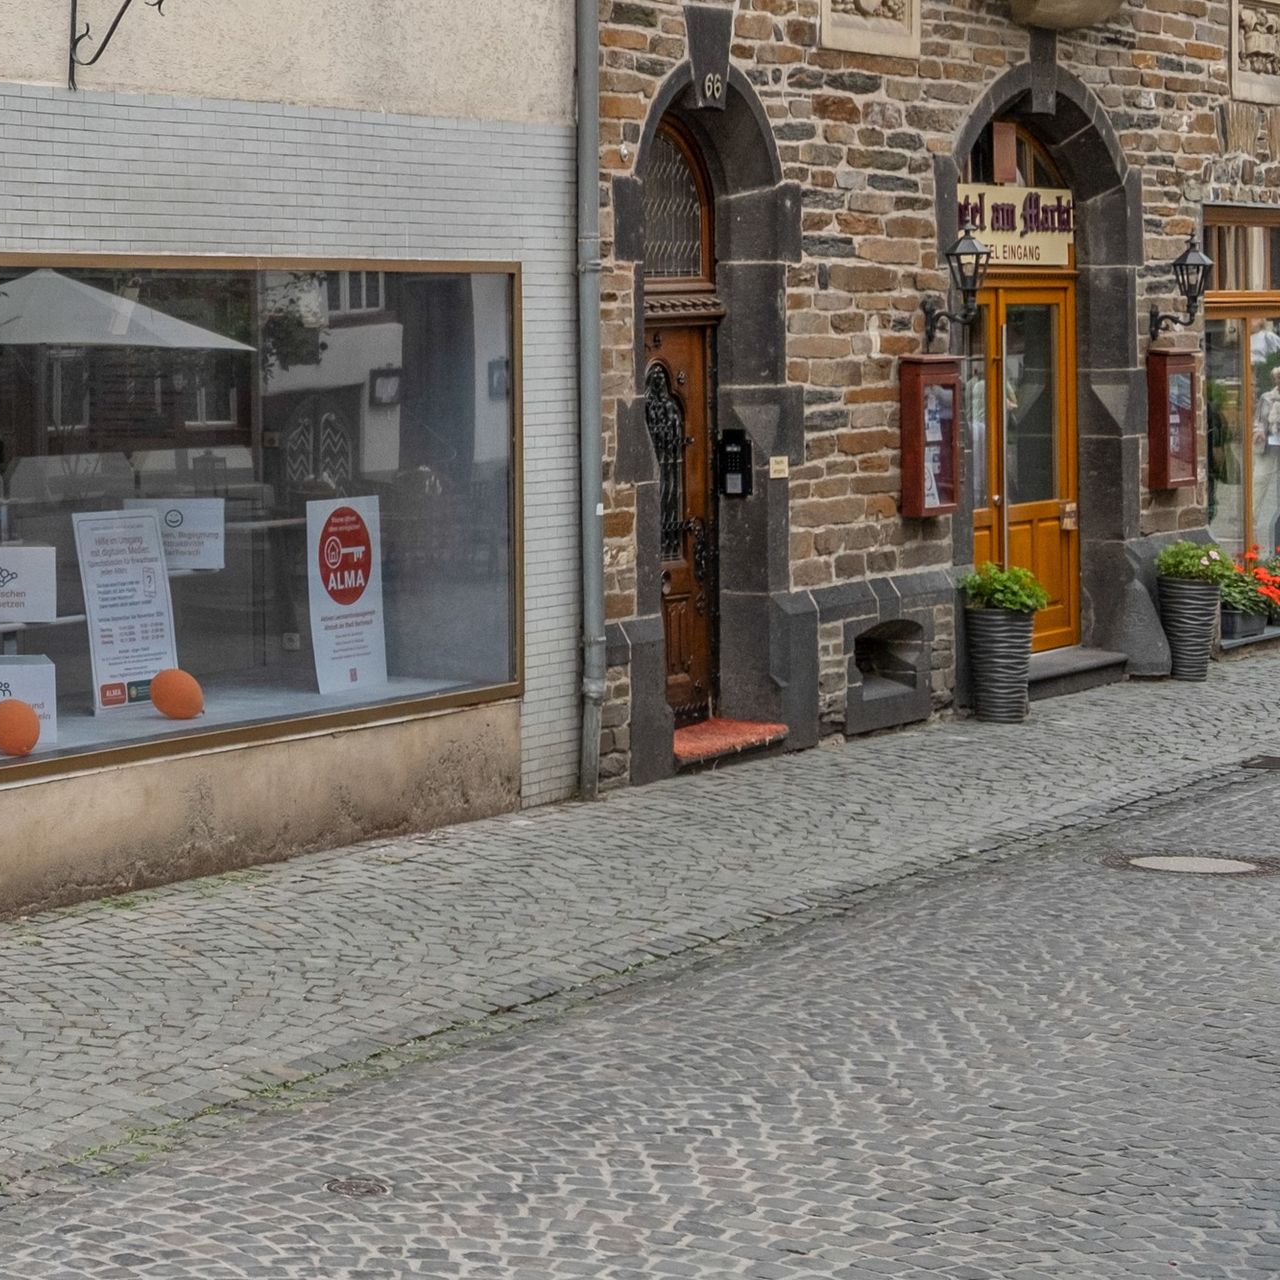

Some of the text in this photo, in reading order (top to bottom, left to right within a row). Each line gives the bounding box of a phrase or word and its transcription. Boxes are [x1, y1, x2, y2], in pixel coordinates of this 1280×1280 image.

[704, 72, 722, 99] 66
[991, 202, 1017, 232] am
[1002, 244, 1040, 261] EINGANG
[328, 568, 365, 591] ALMA
